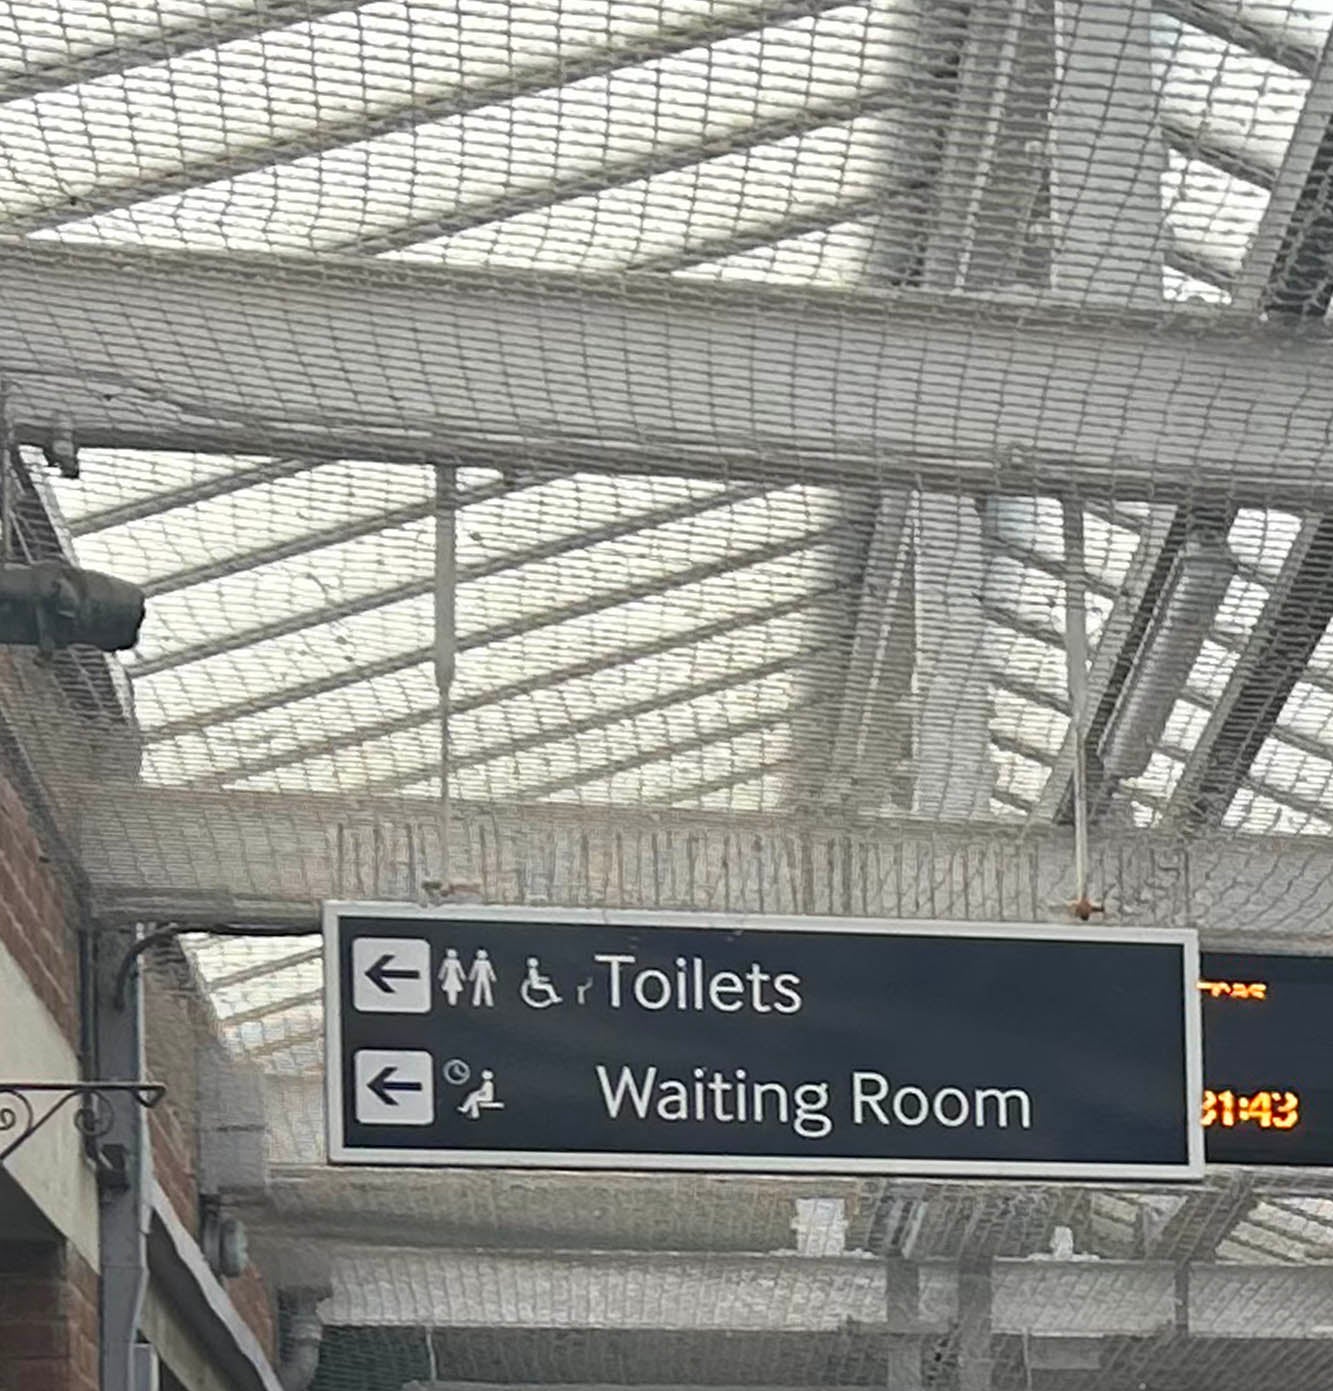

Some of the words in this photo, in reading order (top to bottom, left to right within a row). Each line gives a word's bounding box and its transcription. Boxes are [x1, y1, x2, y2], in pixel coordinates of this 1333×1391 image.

[594, 953, 802, 1014] Toilets
[595, 1064, 832, 1138] Waiting
[852, 1070, 1032, 1129] Room
